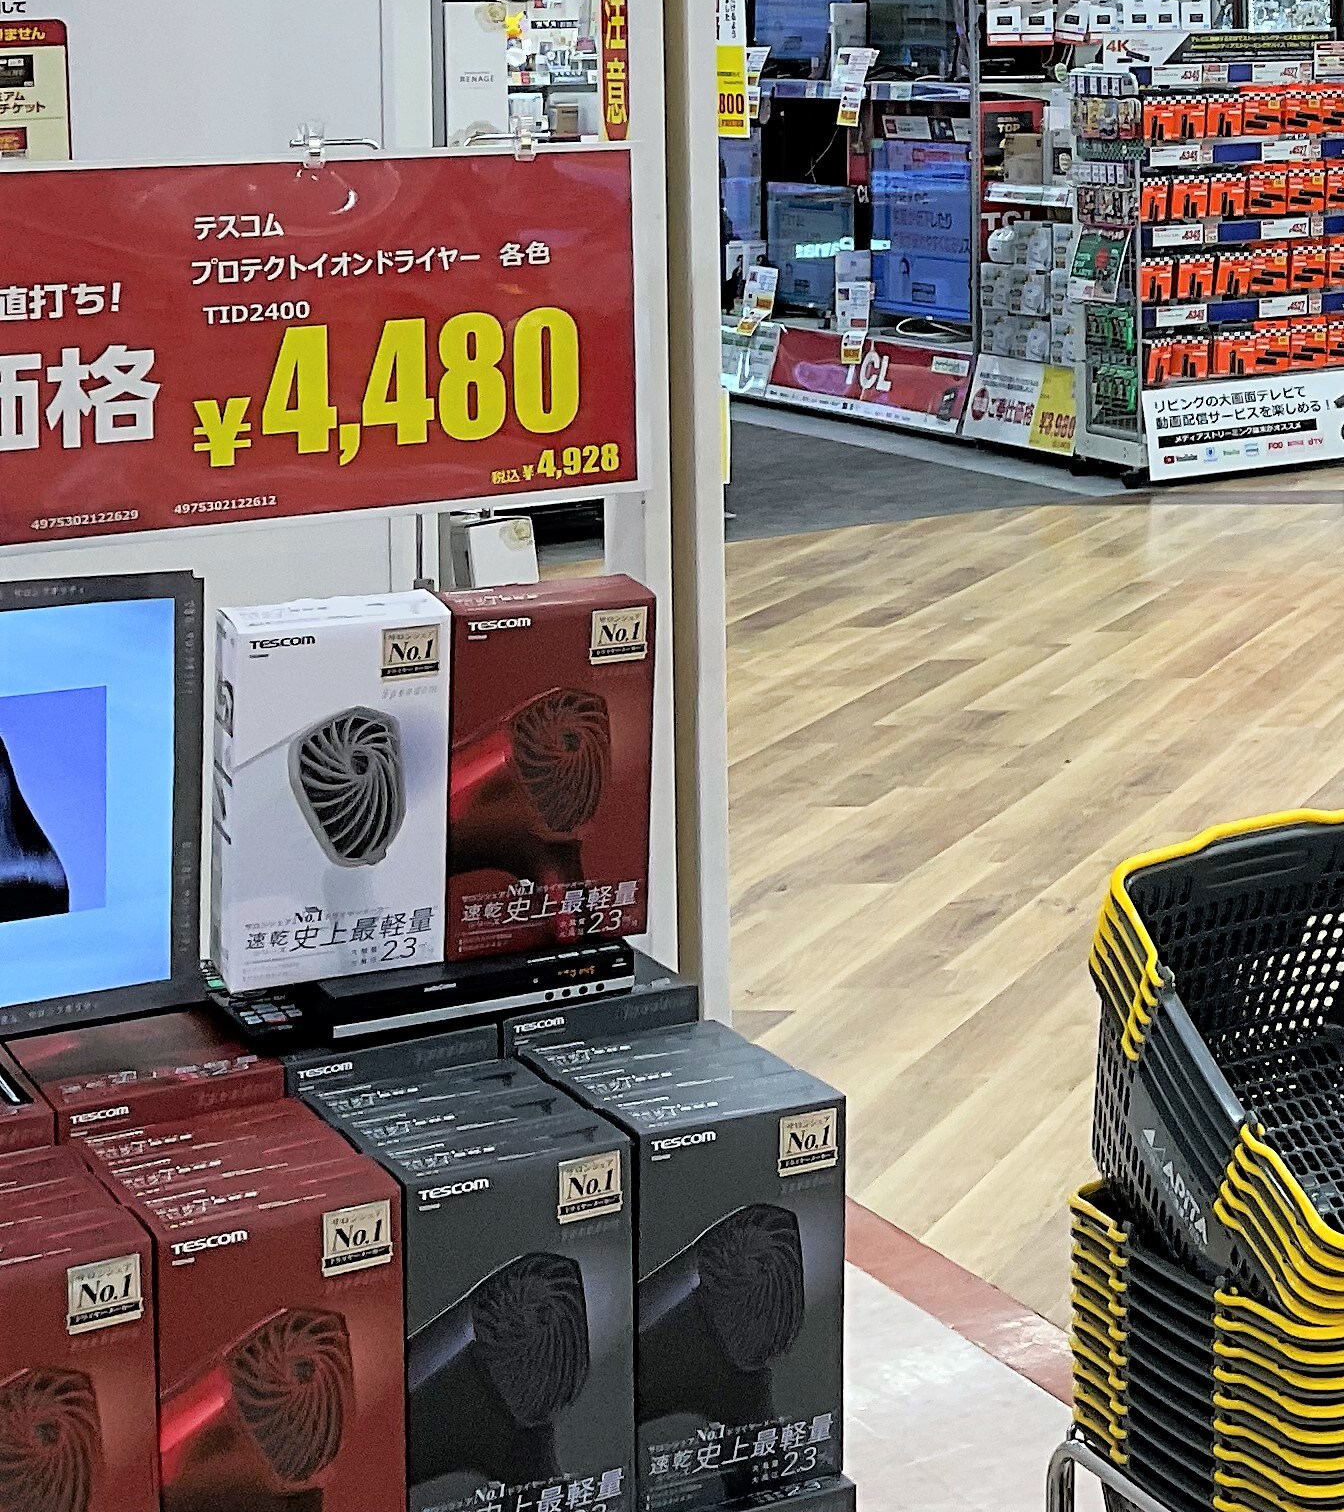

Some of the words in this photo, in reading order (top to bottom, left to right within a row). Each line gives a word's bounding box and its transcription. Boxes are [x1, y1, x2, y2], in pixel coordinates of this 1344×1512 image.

[1105, 40, 1128, 53] 4K
[193, 213, 284, 240] テスコム
[192, 246, 480, 287] プロテクトイオンドライヤー
[499, 242, 551, 268] 各色
[203, 302, 310, 325] TID2400
[193, 307, 579, 468] ¥4,480
[522, 445, 619, 480] ¥4,928
[30, 509, 138, 531] 4975302122629
[174, 495, 277, 515] 4975302122612
[467, 617, 531, 632] TESCOM
[600, 621, 641, 646] No.1
[249, 634, 315, 651] TESCOM
[388, 638, 434, 664] No.1
[513, 1017, 565, 1034] TESCOM
[298, 1062, 353, 1079] TESCOM
[70, 1106, 129, 1124] TESCOM
[651, 1130, 716, 1152] TESCOM
[787, 1125, 832, 1156] No.1
[418, 1178, 489, 1201] TESCOM
[568, 1169, 614, 1199] No.1
[171, 1230, 248, 1255] TESCOM
[333, 1220, 382, 1251] No.1
[79, 1275, 131, 1308] No.1
